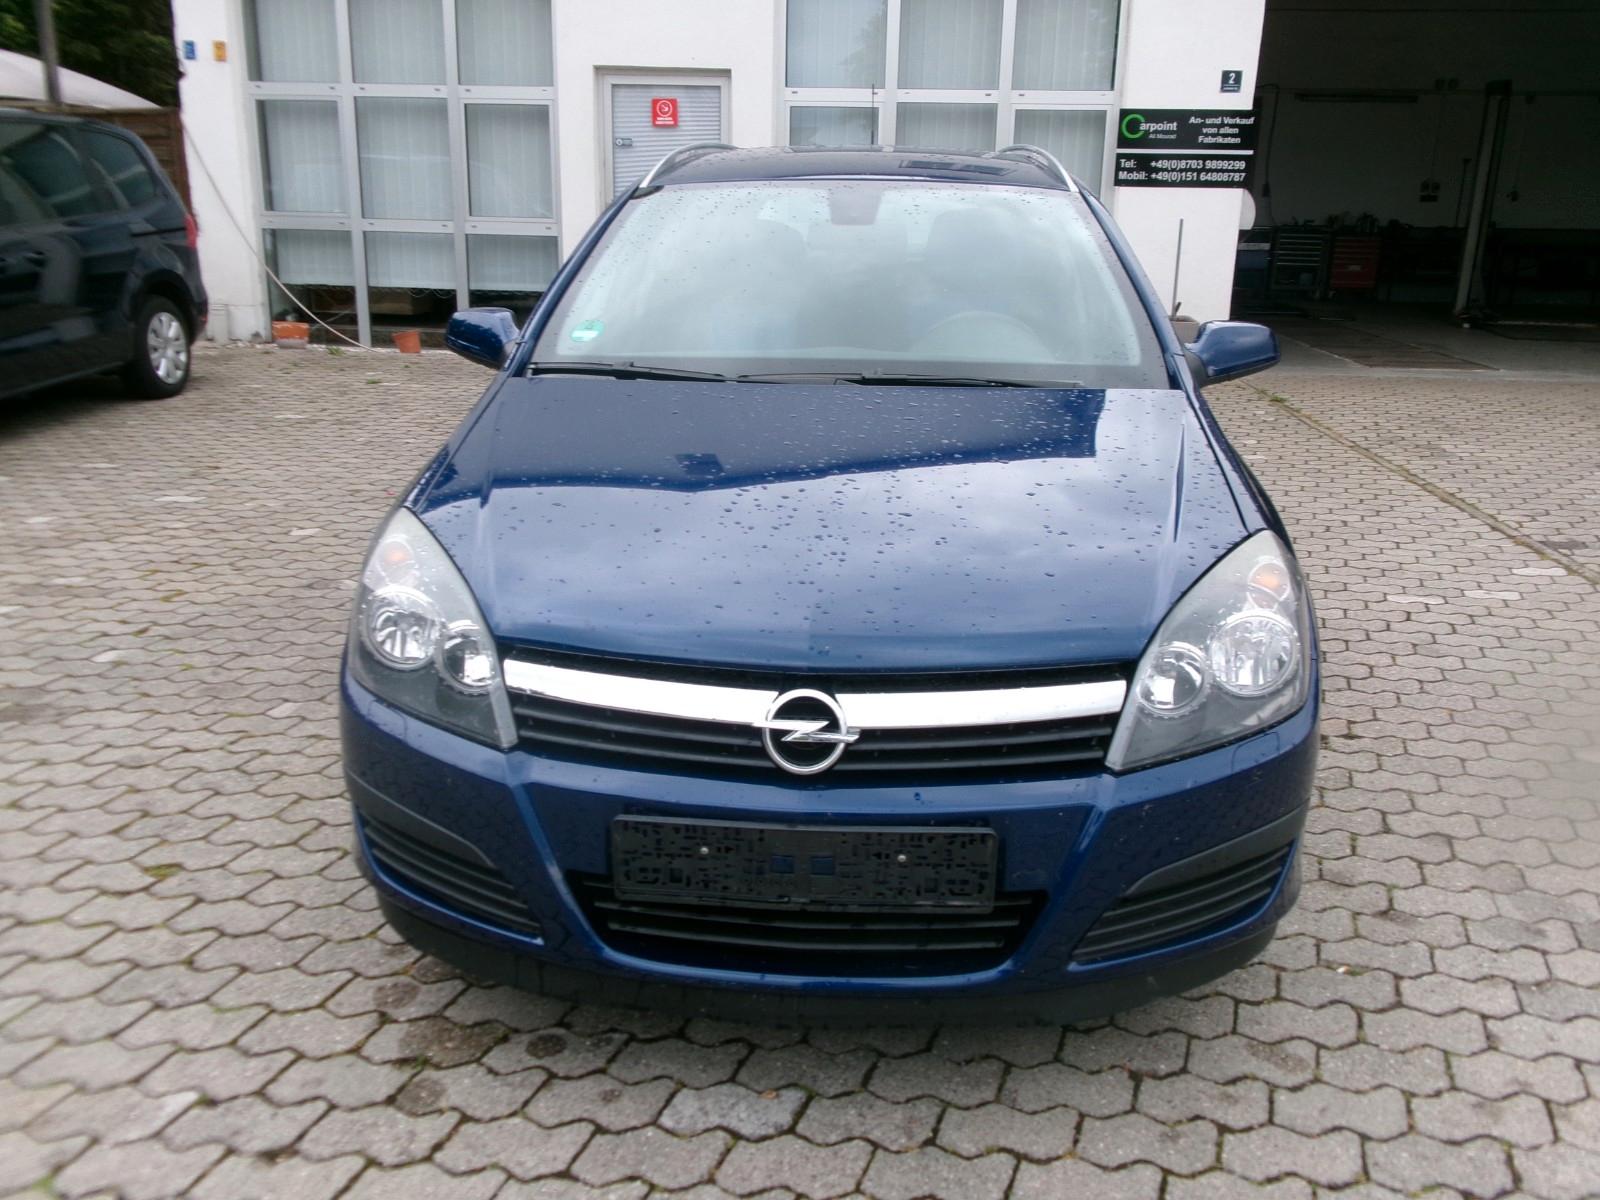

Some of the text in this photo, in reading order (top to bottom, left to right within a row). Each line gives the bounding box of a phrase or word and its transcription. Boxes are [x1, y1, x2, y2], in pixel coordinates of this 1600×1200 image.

[1228, 72, 1236, 84] 2
[1121, 113, 1178, 139] Carpoint
[1188, 116, 1255, 125] An- und Verkauf
[1219, 126, 1239, 134] allen
[1198, 135, 1241, 144] Fabrikaten
[1120, 158, 1246, 170] Tel: +49(0)8703 9899299
[1118, 170, 1149, 180] Mobil:
[1150, 171, 1198, 182] +49(0)151
